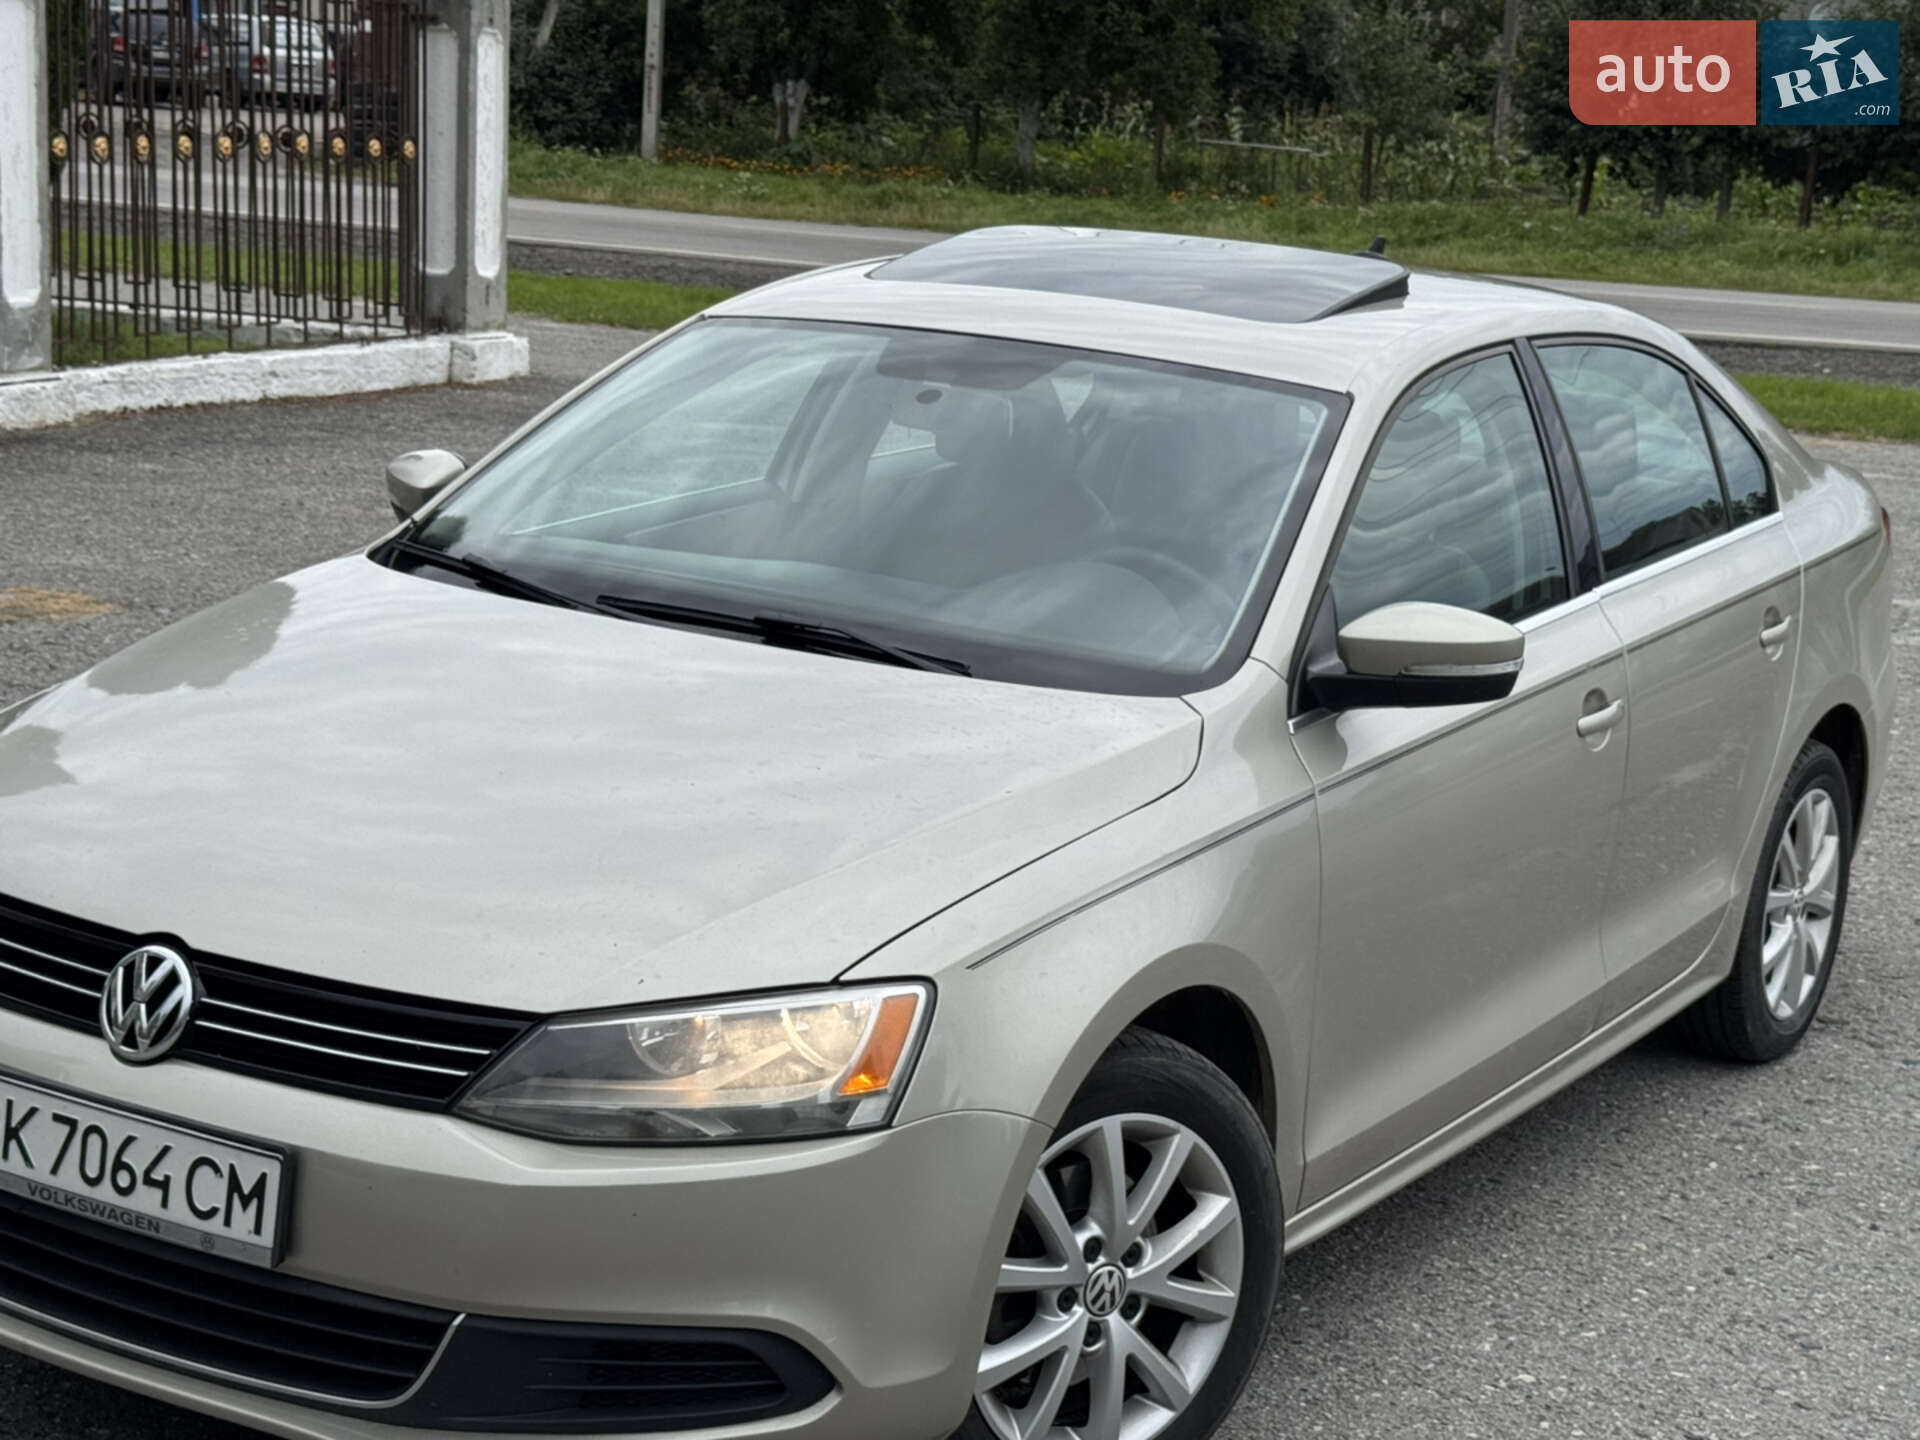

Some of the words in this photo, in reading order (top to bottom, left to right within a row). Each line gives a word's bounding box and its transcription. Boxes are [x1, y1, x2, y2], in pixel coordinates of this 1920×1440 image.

[27, 1182, 161, 1234] VOLKSWAGEN
[50, 1112, 173, 1209] 7064
[185, 1156, 268, 1236] CM
